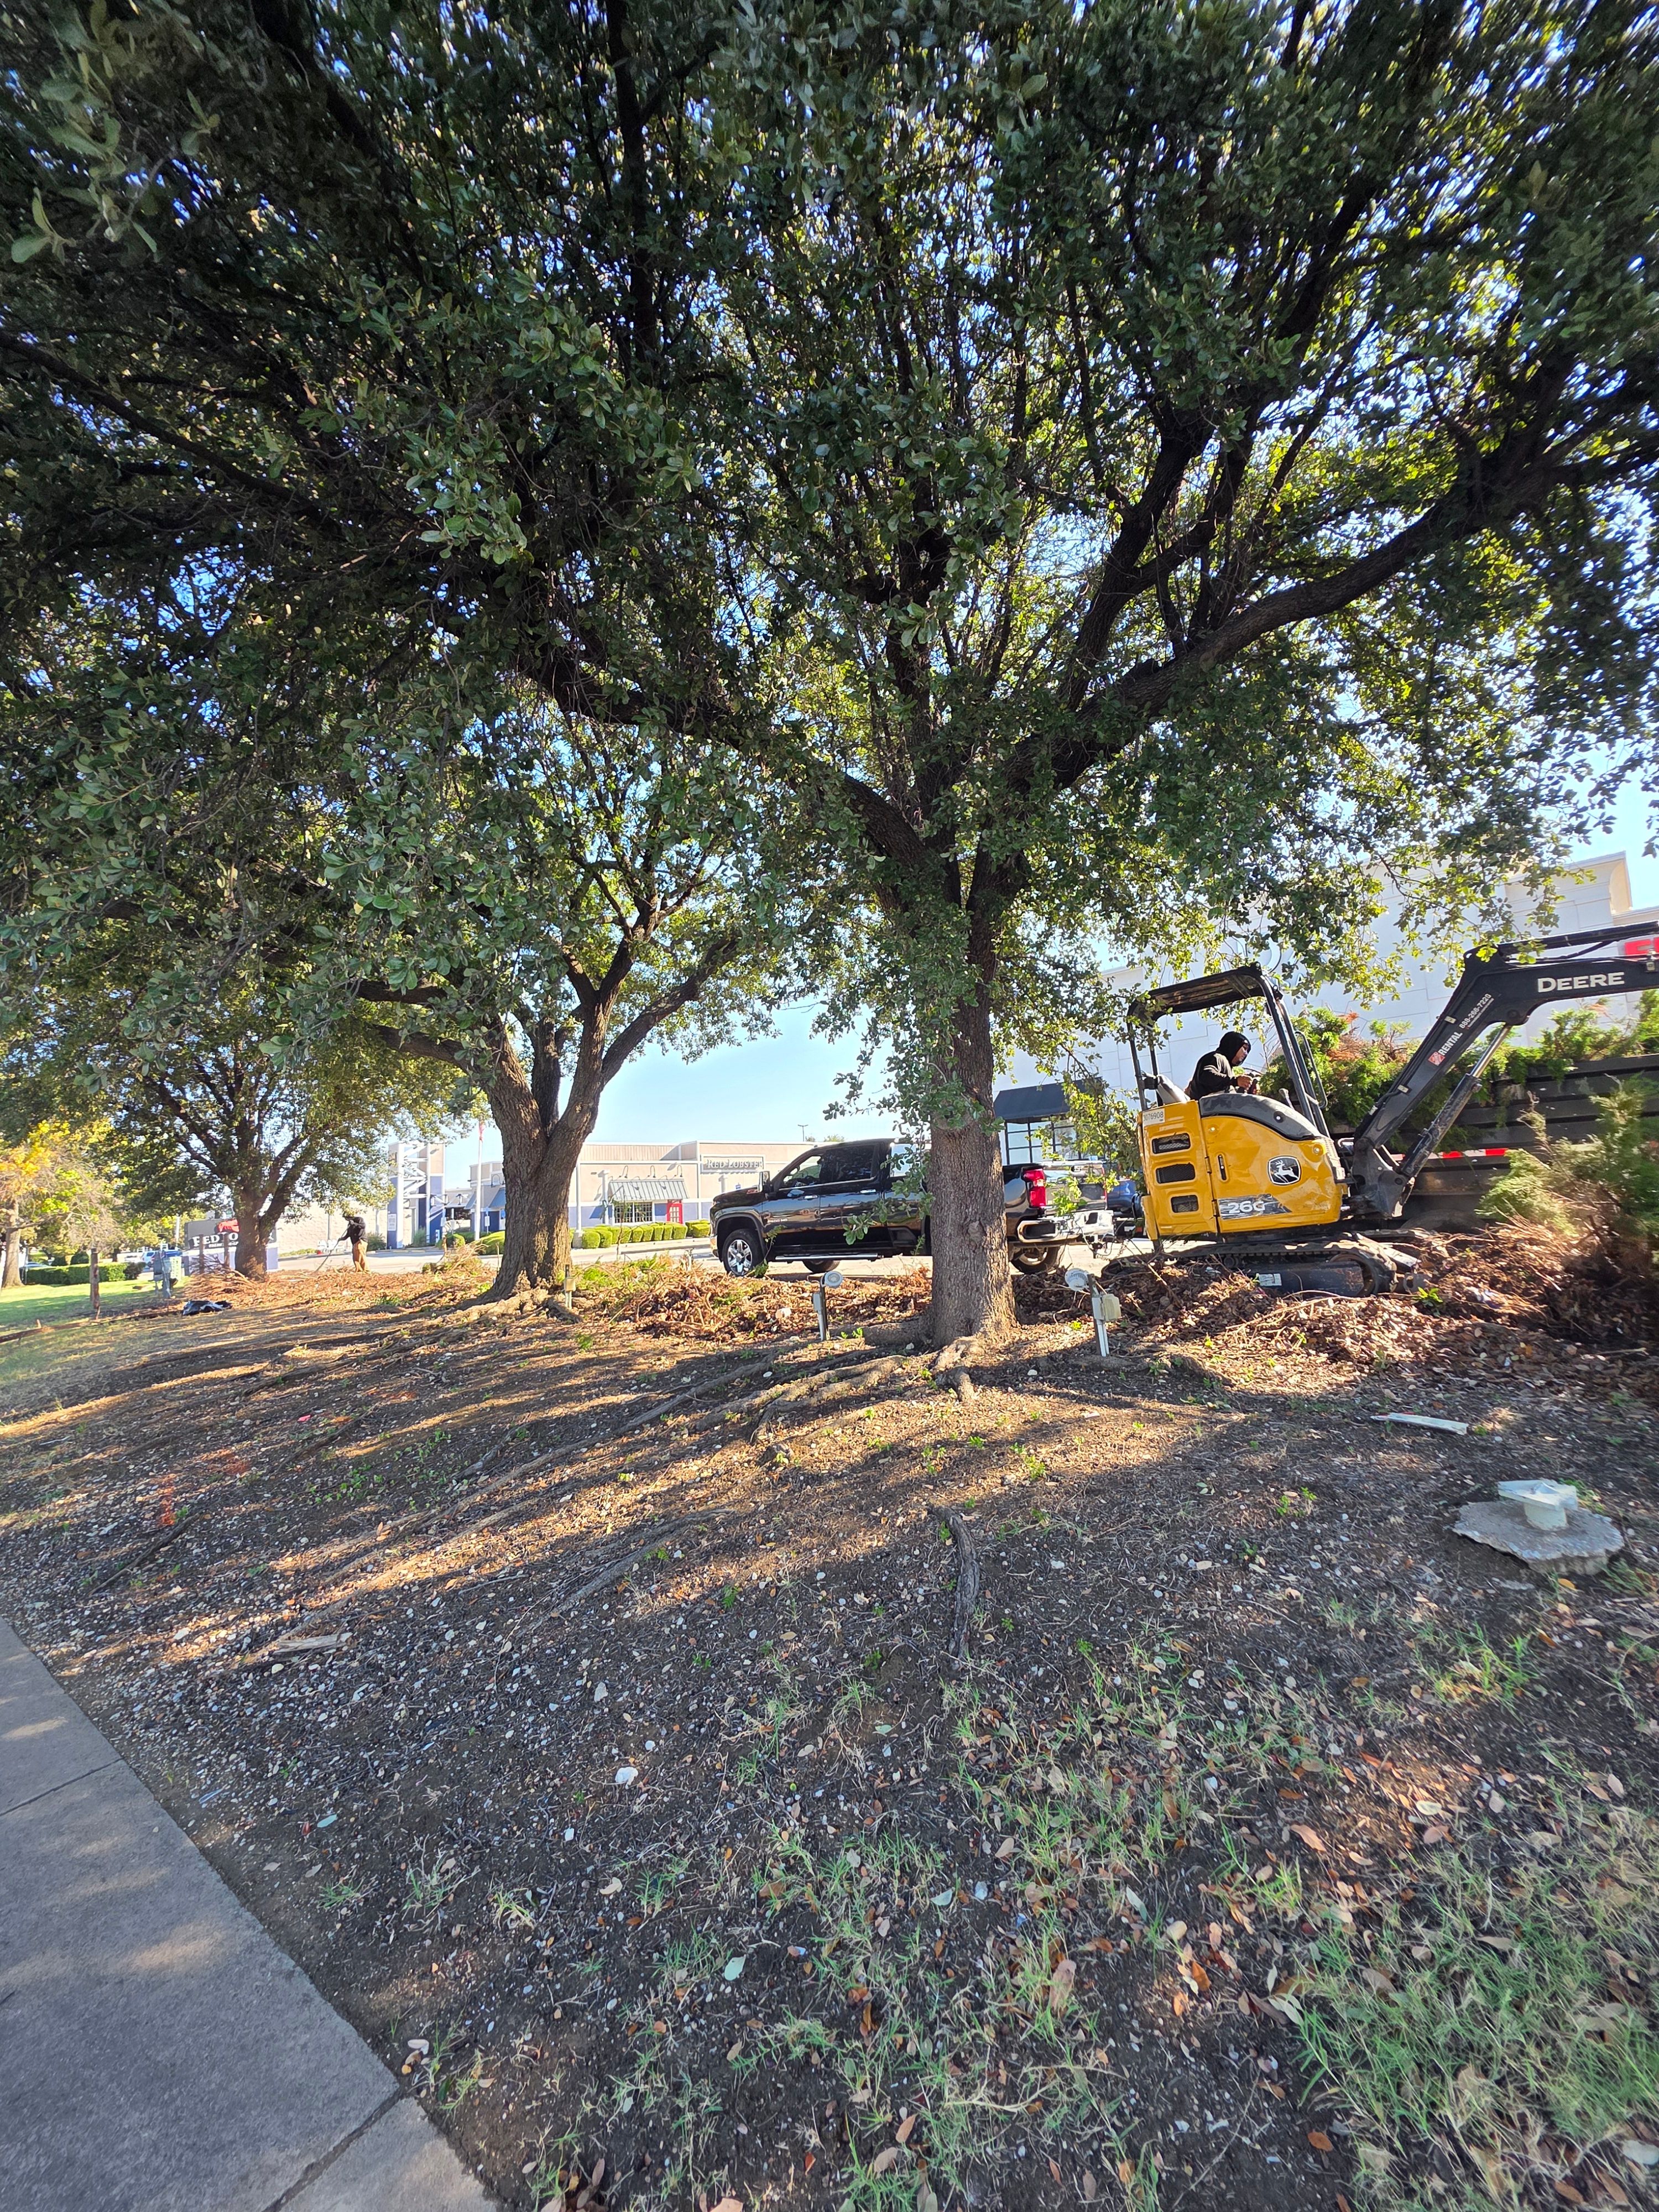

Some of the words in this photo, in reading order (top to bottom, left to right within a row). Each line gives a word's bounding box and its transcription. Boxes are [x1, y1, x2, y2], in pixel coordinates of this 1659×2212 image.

[1537, 972, 1625, 993] DEERE
[1438, 1031, 1463, 1056] RENTAL
[1228, 1200, 1265, 1214] 26G
